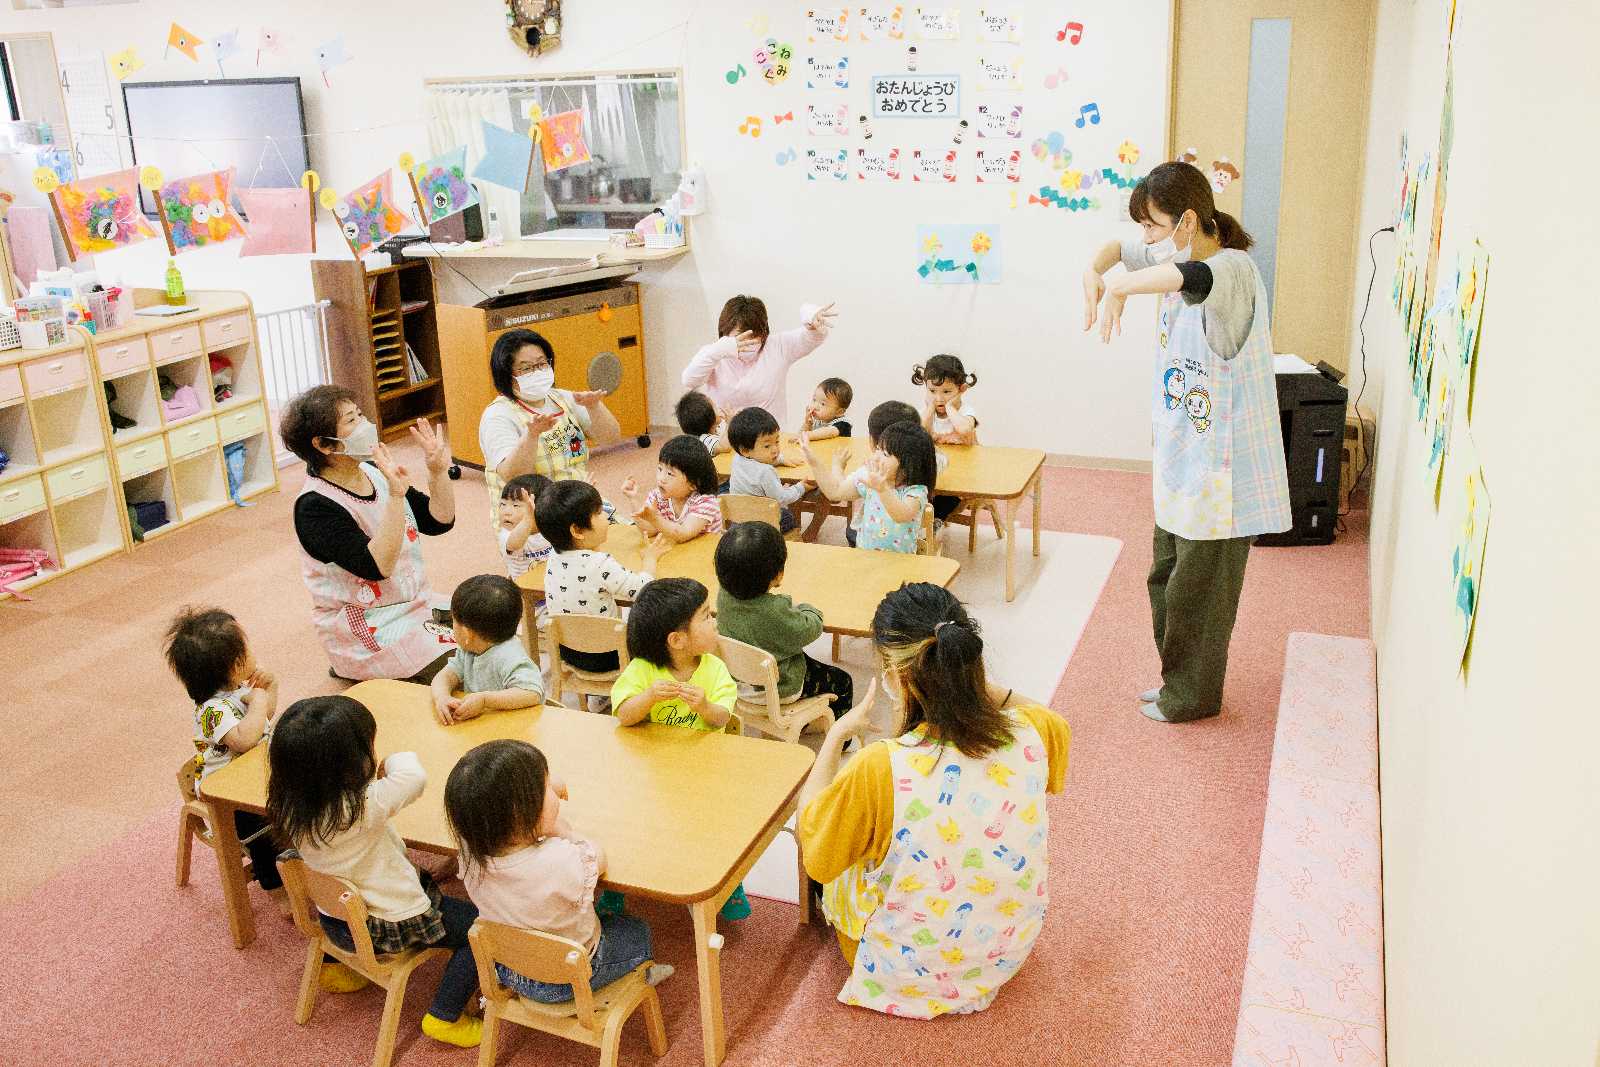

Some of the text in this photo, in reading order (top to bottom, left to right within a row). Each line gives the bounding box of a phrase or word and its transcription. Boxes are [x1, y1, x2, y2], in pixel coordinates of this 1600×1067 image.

[62, 70, 70, 95] 4
[876, 80, 956, 96] おたんじょうび
[881, 97, 947, 112] おめでとう
[105, 105, 113, 130] 5
[76, 142, 84, 166] 6
[512, 313, 538, 325] SUZUKI
[657, 704, 698, 728] Rady
